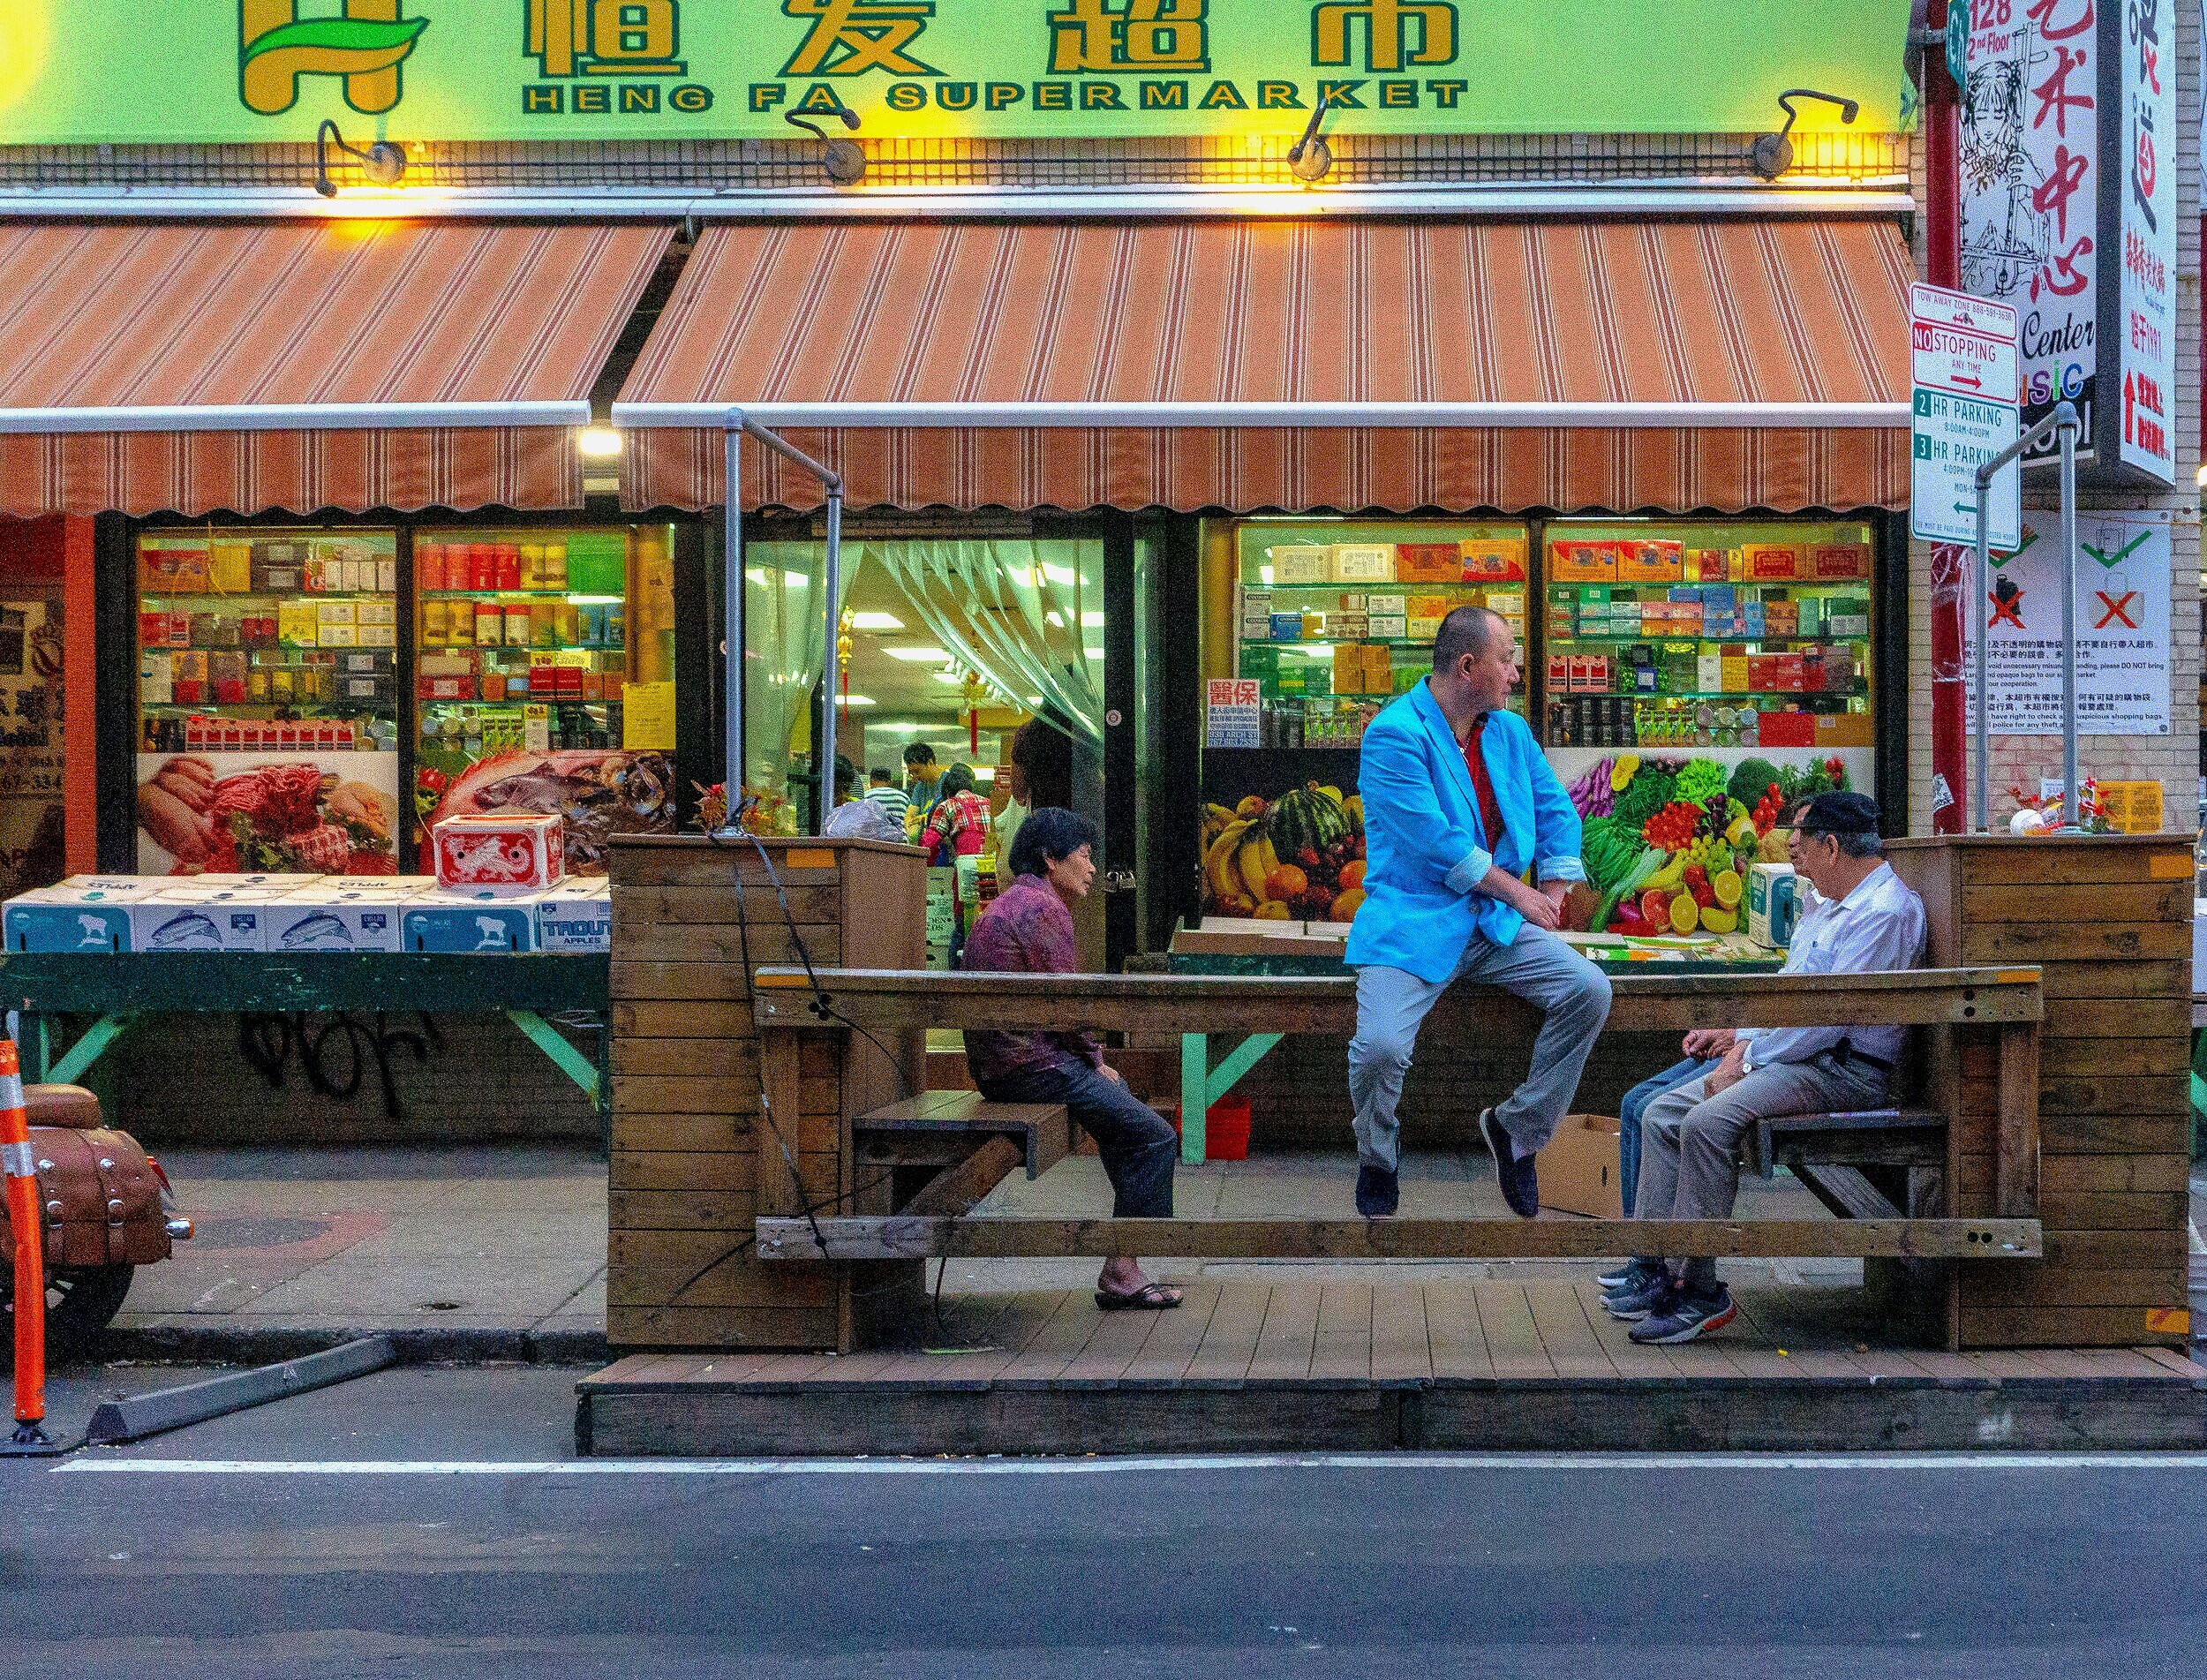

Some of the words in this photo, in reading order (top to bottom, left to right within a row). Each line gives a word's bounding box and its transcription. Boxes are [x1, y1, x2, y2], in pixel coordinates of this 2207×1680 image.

[1987, 32, 2010, 55] Floor
[523, 85, 713, 113] HENG
[749, 81, 844, 112] FA
[887, 79, 1469, 112] SUPERMARKET
[1917, 291, 1931, 303] TOW
[1933, 296, 1952, 308] AWAY
[1955, 299, 1970, 312] ZONE
[1914, 328, 1932, 349] NO
[1934, 333, 1996, 362] STOPPING
[2022, 311, 2095, 360] Center
[1952, 359, 1964, 370] ANY
[1968, 362, 1982, 373] TIME
[1919, 394, 1926, 413] 2
[1933, 396, 1947, 417] HR
[1955, 402, 2002, 427] PARKING
[1919, 437, 1926, 456] 3
[1933, 440, 1948, 459] HR
[2148, 662, 2165, 671] bring
[1209, 682, 1257, 705] 醫保
